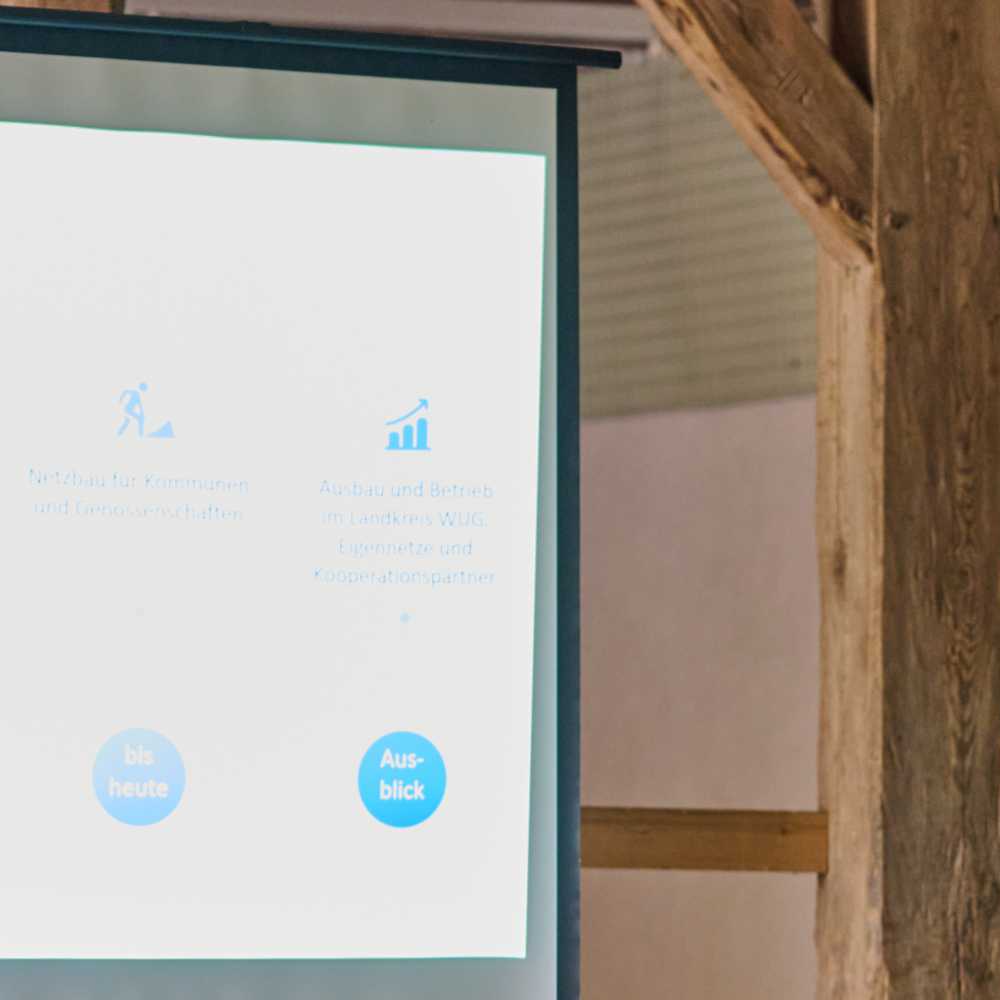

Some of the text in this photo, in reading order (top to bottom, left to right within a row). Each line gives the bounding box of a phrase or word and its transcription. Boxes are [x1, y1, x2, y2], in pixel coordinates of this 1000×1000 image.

[144, 471, 249, 494] Kommunen
[319, 479, 494, 499] Ausbau und Betrieb
[34, 497, 70, 516] und
[350, 509, 433, 528] Landkreis
[338, 538, 472, 559] Eigennetze und
[313, 566, 495, 590] Kooperationspartner
[123, 744, 155, 766] bis
[380, 748, 425, 769] Aus-
[108, 776, 169, 799] heute
[379, 779, 425, 801] blick
